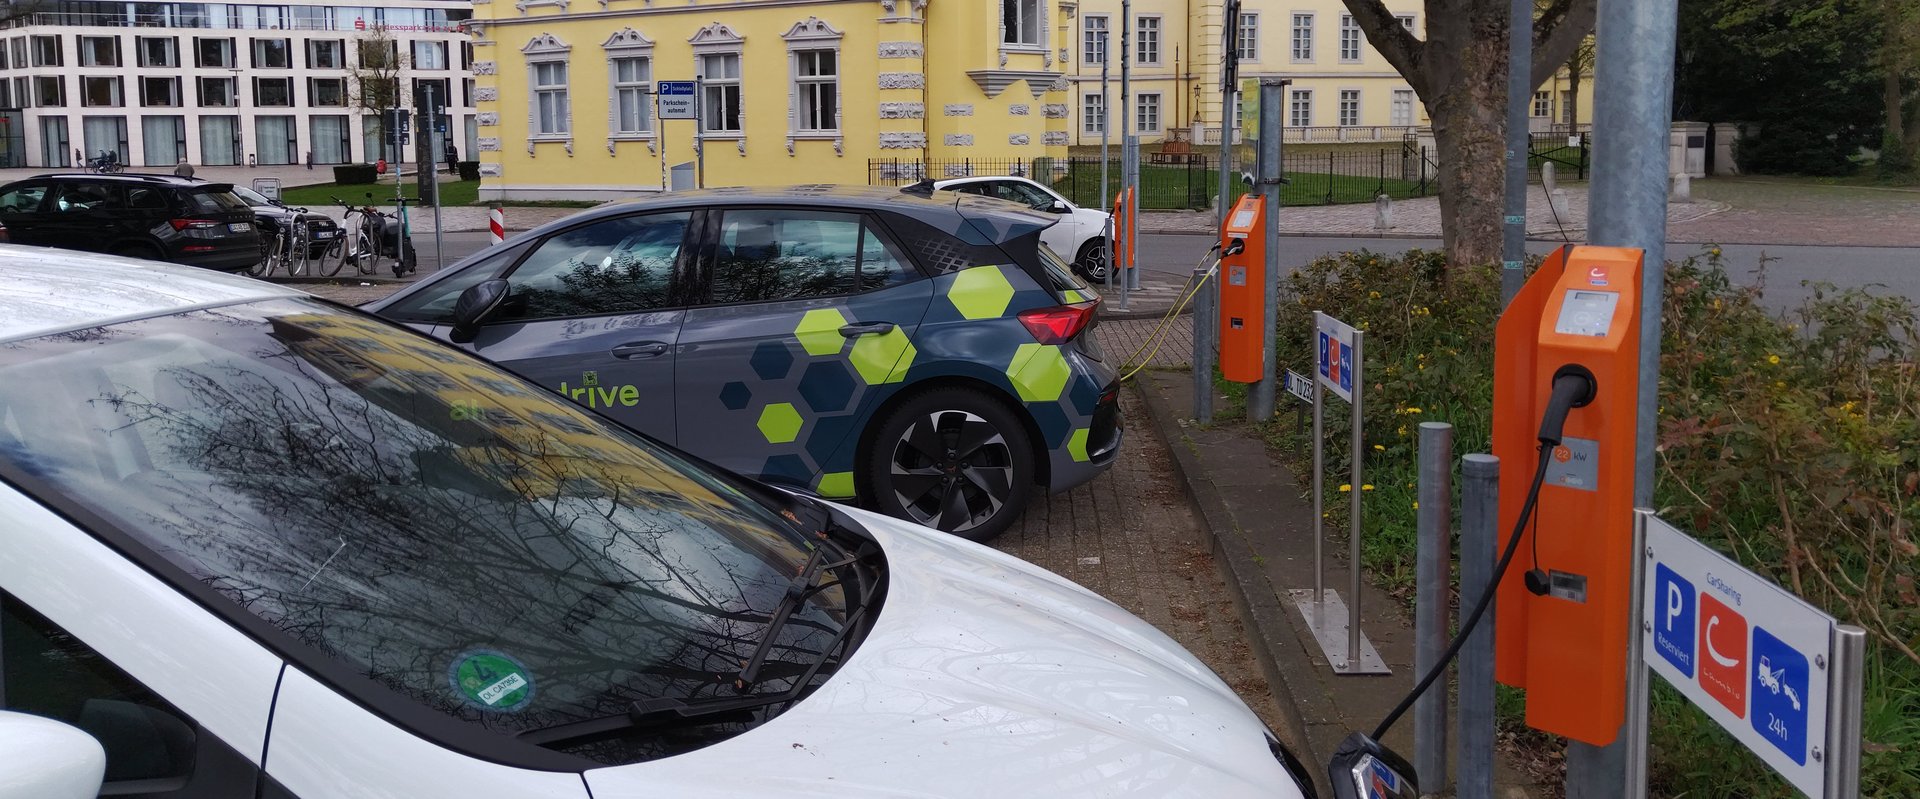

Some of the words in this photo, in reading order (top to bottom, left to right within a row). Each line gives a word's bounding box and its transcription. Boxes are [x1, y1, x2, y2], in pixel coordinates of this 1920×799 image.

[661, 83, 669, 94] P
[1556, 449, 1569, 459] 22
[1573, 450, 1587, 462] kW
[1706, 571, 1742, 606] CarSharing
[1666, 580, 1683, 632] P
[1657, 632, 1690, 667] Reserviert
[471, 660, 498, 681] 4
[482, 691, 495, 700] OL
[1768, 712, 1788, 741] 24h
